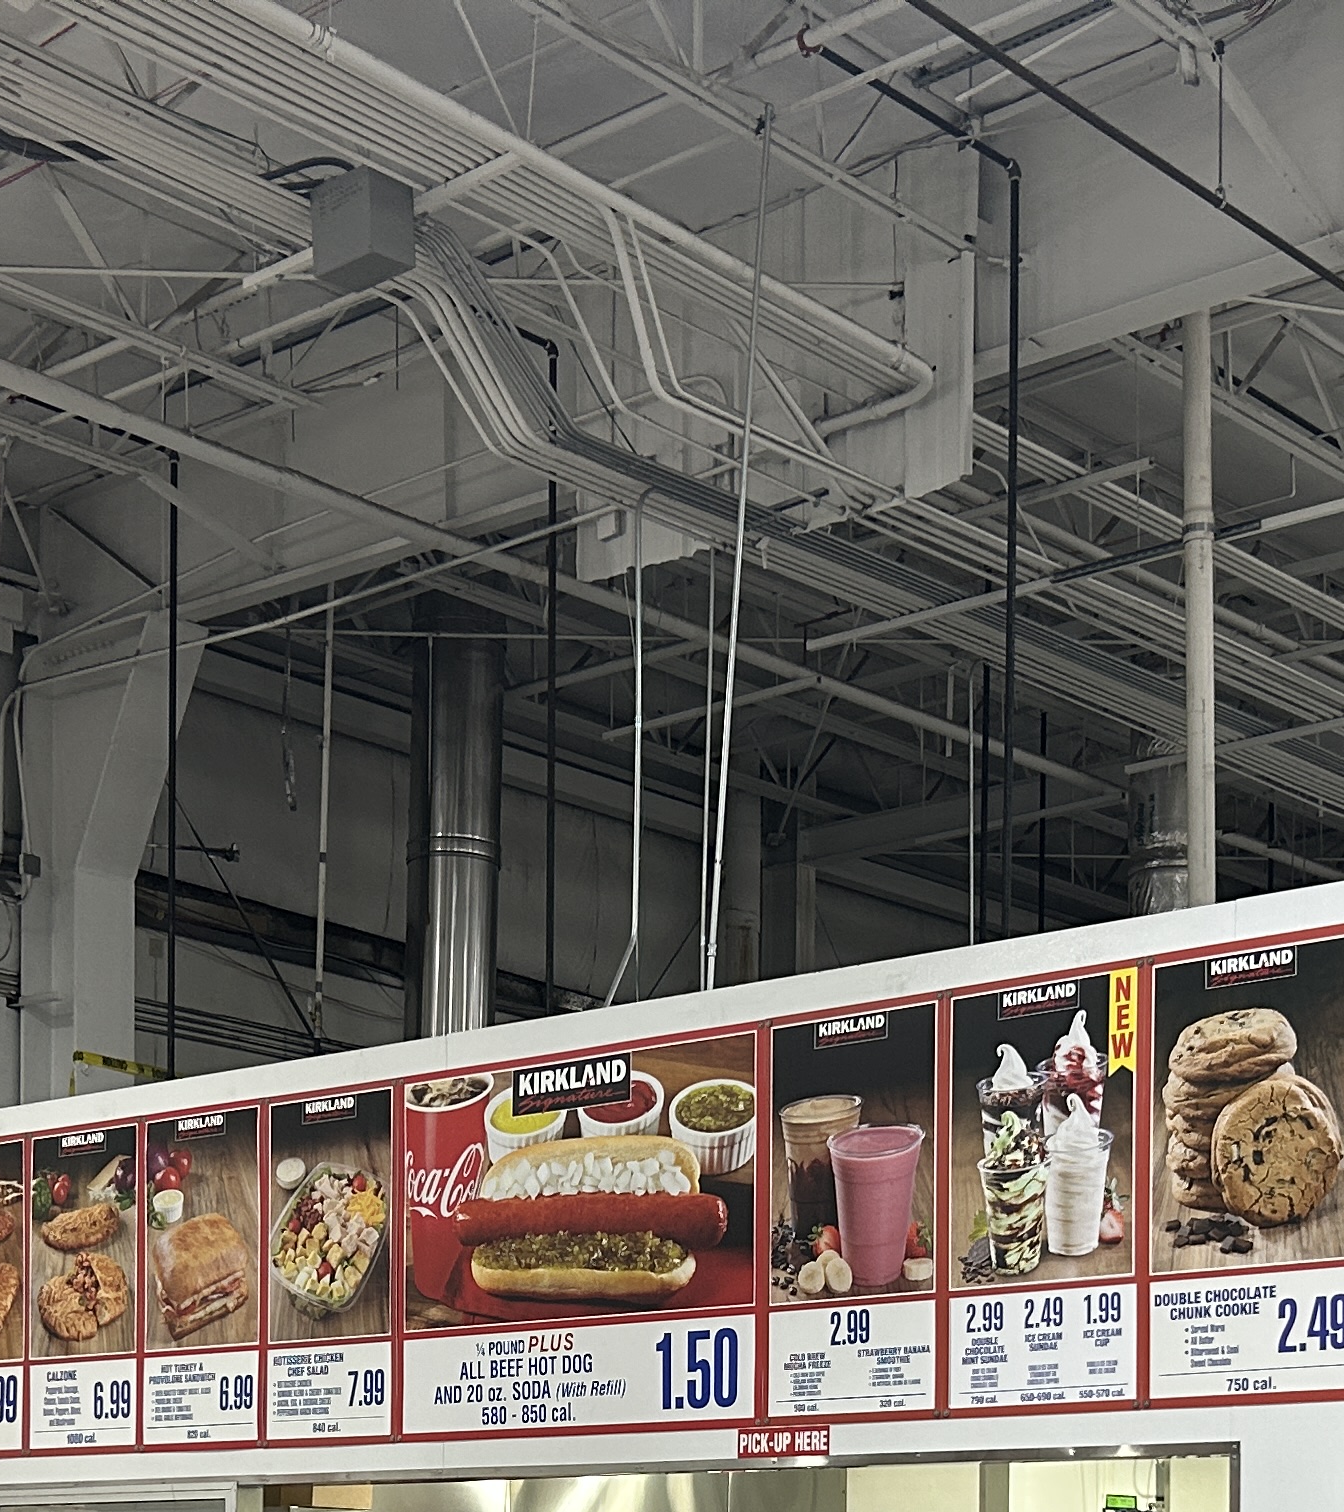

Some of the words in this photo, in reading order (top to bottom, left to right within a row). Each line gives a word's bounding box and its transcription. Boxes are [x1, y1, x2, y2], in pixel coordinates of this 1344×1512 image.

[1210, 949, 1293, 976] KIRKLAND
[1002, 983, 1077, 1009] KIRKLAND
[818, 1014, 885, 1037] KIRKLAND
[1113, 975, 1133, 1060] NEW
[518, 1059, 627, 1097] KIRKLAND
[305, 1097, 354, 1114] KIRKLAND
[518, 1086, 626, 1116] Signature
[178, 1114, 224, 1131] KIRKLAND
[61, 1131, 105, 1148] KIRKLAND
[1154, 1291, 1201, 1307] DOUBLE
[1205, 1285, 1277, 1303] CHOCOLATE
[966, 1301, 1004, 1333] 2.99
[1024, 1296, 1064, 1329] 2.49
[1083, 1291, 1121, 1325] 1.99
[1170, 1305, 1212, 1321] CHUNK
[1215, 1302, 1260, 1317] COOKIE
[830, 1308, 870, 1346] 2.99
[1083, 1330, 1095, 1339] ICE
[1096, 1327, 1123, 1338] CREAM
[488, 1340, 525, 1356] POUND
[528, 1332, 574, 1354] PLUS
[971, 1337, 999, 1346] DOUBLE
[1024, 1333, 1036, 1343] ICE
[1037, 1331, 1063, 1342] CREAM
[1094, 1338, 1110, 1347] CUP
[857, 1346, 902, 1358] STRAWBERRY
[903, 1345, 931, 1354] BANANA
[965, 1345, 1005, 1356] CHOCOLATE
[1029, 1342, 1058, 1352] SUNDAE
[314, 1352, 344, 1363] CHICKEN
[808, 1360, 831, 1369] FREEZE
[876, 1355, 911, 1365] SMOOTHIE
[962, 1356, 979, 1365] MINT
[980, 1354, 1008, 1364] SUNDAE
[161, 1364, 173, 1373] HOT
[174, 1363, 197, 1373] TURKEY
[287, 1366, 305, 1377] CHEF
[307, 1365, 329, 1376] SALAD
[460, 1360, 485, 1380] ALL
[490, 1358, 523, 1379] BEEF
[528, 1356, 556, 1377] HOT
[562, 1354, 593, 1374] DOG
[655, 1327, 739, 1411] 1.50
[46, 1370, 78, 1383] CALZONE
[1226, 1378, 1249, 1392] 750
[1253, 1376, 1277, 1390] cal.
[219, 1374, 254, 1411] 6.99
[347, 1368, 385, 1407] 7.99
[434, 1385, 462, 1405] AND
[467, 1384, 483, 1403] 20
[488, 1387, 507, 1403] oz.
[512, 1380, 551, 1400] SODA
[555, 1379, 587, 1401] (With
[590, 1377, 627, 1399] Refill)
[94, 1380, 131, 1420] 6.99
[481, 1406, 507, 1425] 580
[521, 1404, 547, 1424] 850
[551, 1402, 576, 1423] cal.
[312, 1423, 326, 1433] 840
[327, 1422, 341, 1432] cal.
[85, 1432, 97, 1443] cal.
[739, 1431, 791, 1454] PICK-UP
[794, 1430, 828, 1452] HERE
